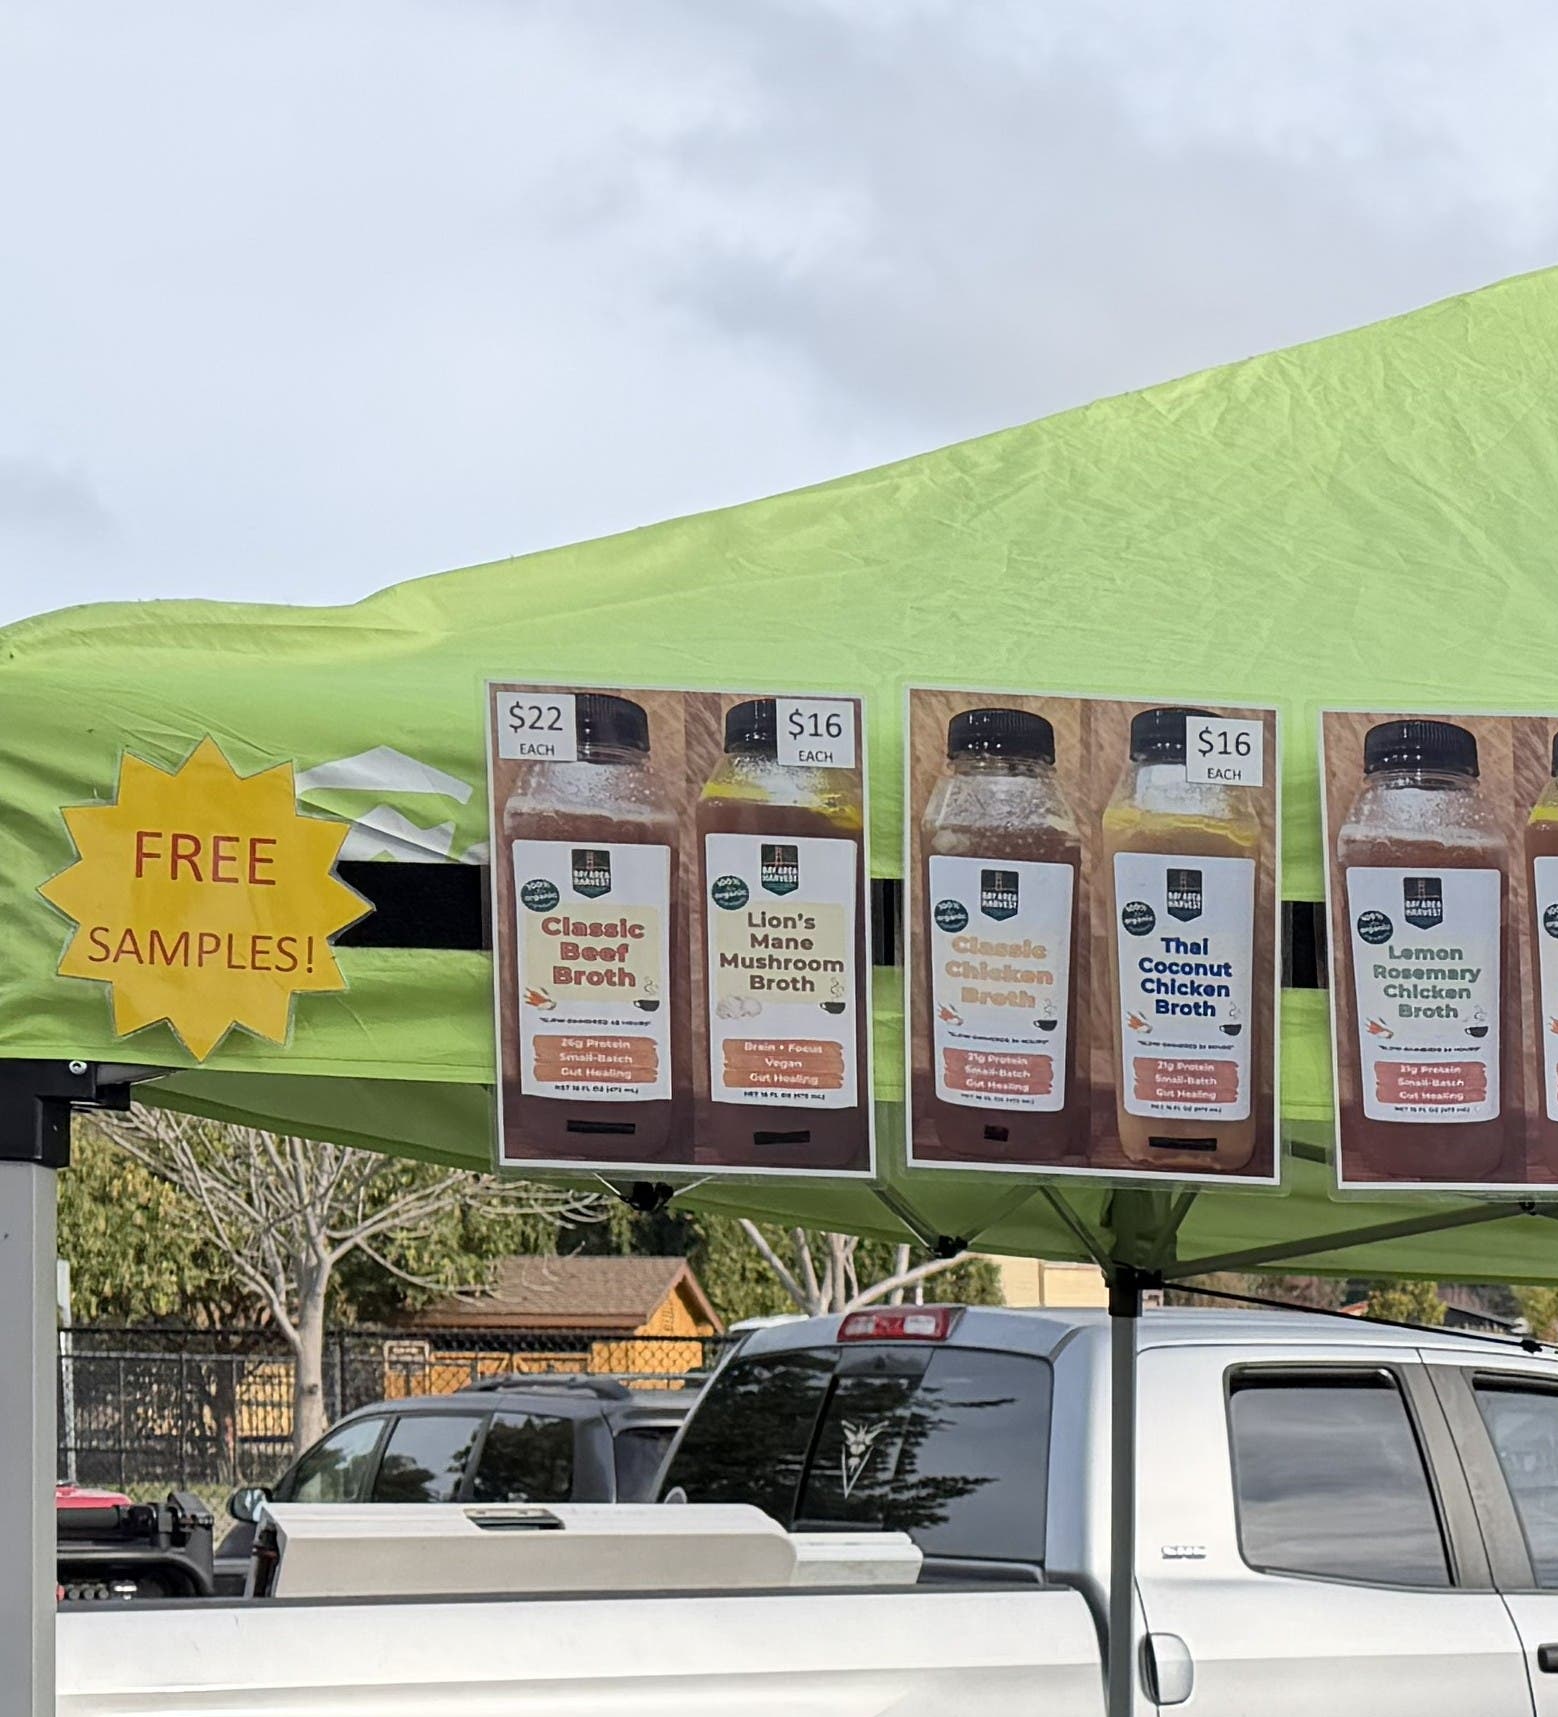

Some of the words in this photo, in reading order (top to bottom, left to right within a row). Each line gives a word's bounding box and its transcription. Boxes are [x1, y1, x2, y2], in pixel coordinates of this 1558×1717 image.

[509, 701, 563, 733] $22
[788, 708, 842, 740] $16
[520, 744, 554, 756] EACH
[1198, 727, 1251, 757] $16
[799, 751, 833, 763] EACH
[1207, 768, 1241, 781] EACH
[134, 831, 276, 886] FREE
[541, 917, 645, 939] Classic
[748, 912, 815, 930] Lion's
[87, 926, 314, 974] SAMPLES!
[750, 933, 814, 950] Mane
[952, 936, 1047, 959] Classic
[1161, 937, 1208, 955] Thai
[560, 942, 629, 962] Beef
[1389, 946, 1463, 960] Lemon
[720, 953, 844, 972] Mushroom
[1139, 958, 1232, 977] Coconut
[553, 966, 636, 987] Broth
[945, 960, 1054, 985] Chicken
[1373, 965, 1481, 983] Rosemary
[750, 975, 815, 992] Broth
[1141, 978, 1230, 997] Chicken
[1383, 984, 1471, 999] Chicken
[961, 987, 1036, 1008] Broth
[1156, 1000, 1216, 1017] Broth
[1399, 1004, 1458, 1018] Broth
